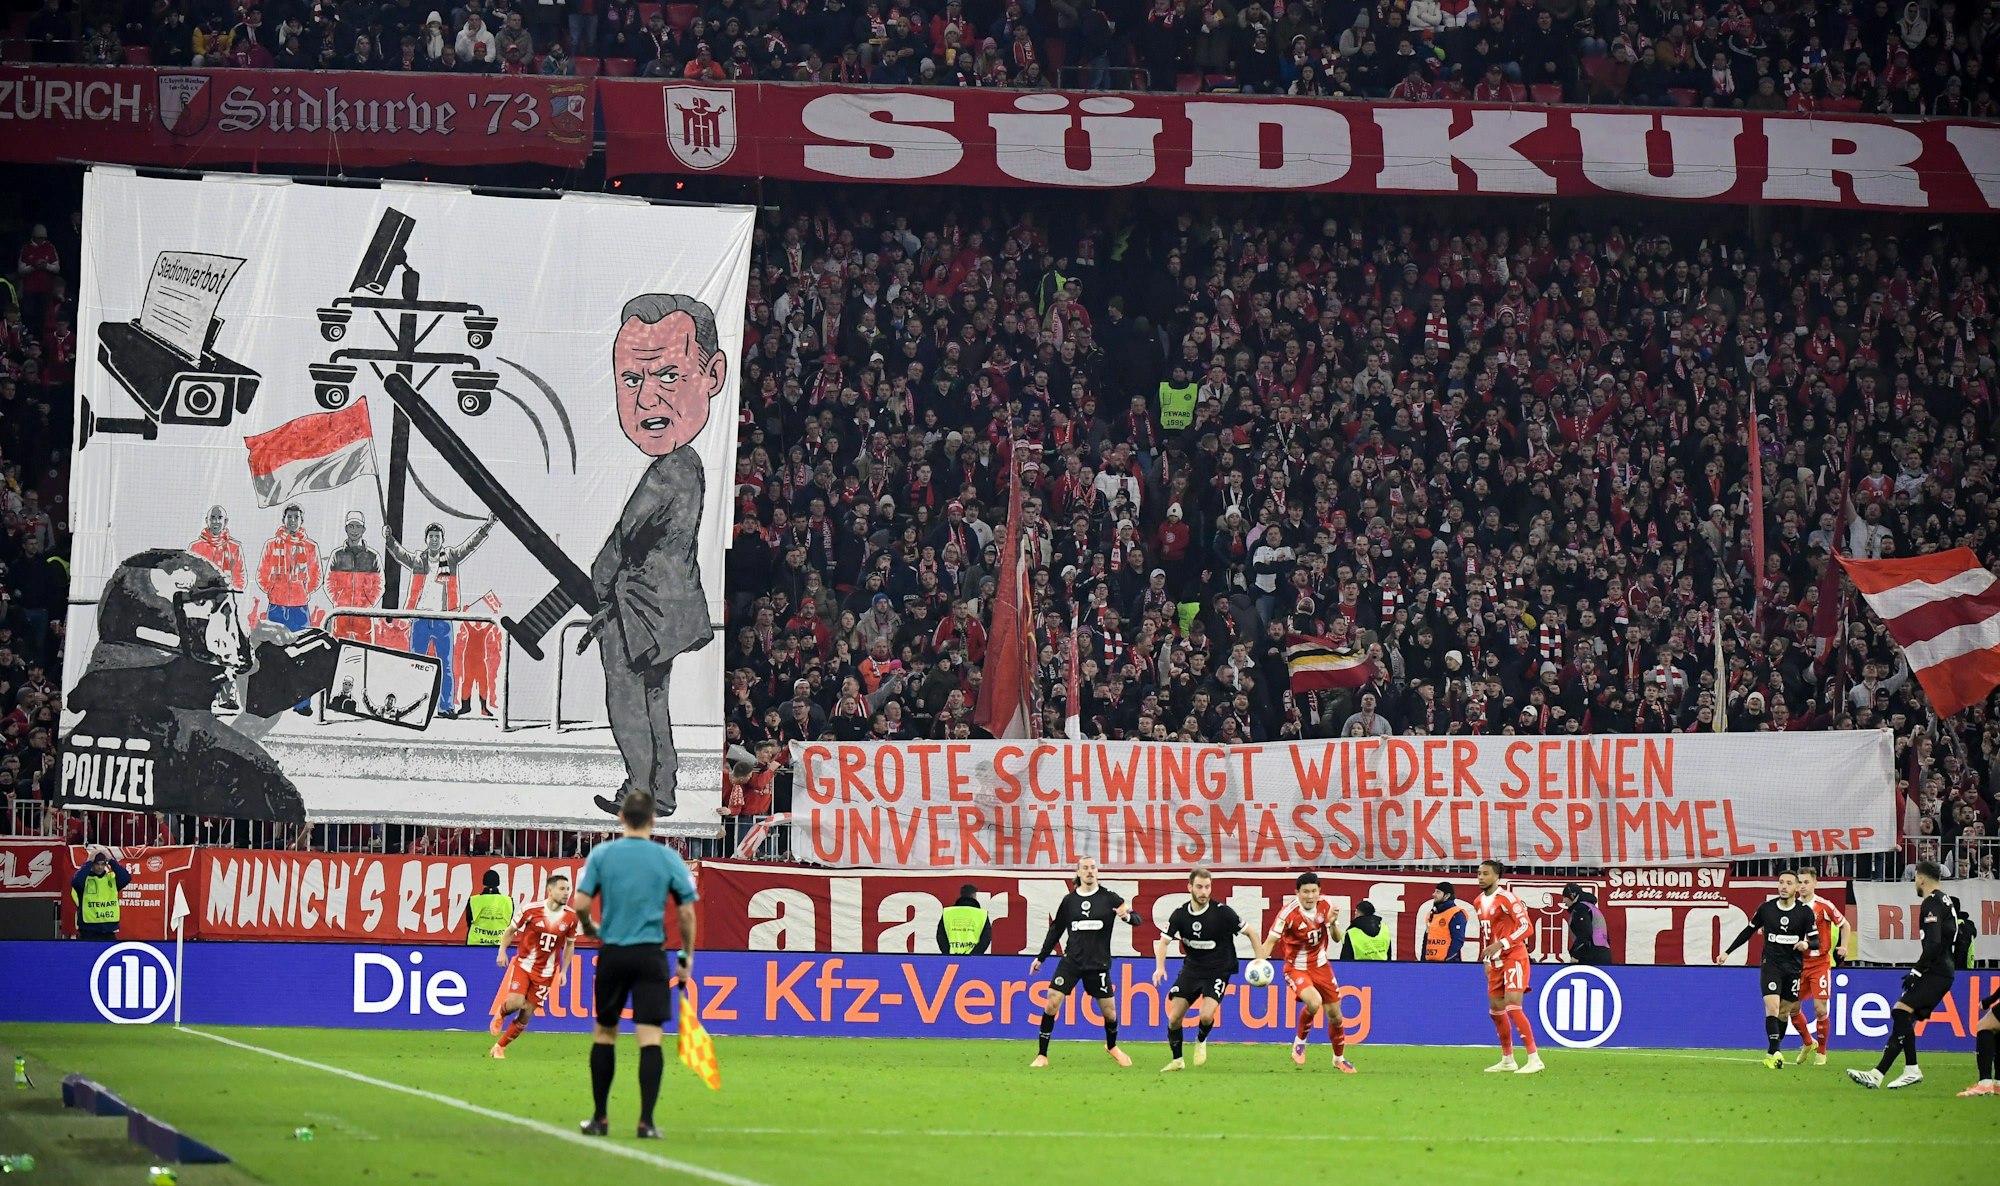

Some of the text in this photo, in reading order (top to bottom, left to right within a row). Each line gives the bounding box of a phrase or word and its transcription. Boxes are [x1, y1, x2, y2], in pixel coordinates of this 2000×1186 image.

[218, 86, 541, 135] Südkurve '73
[157, 256, 228, 295] Stadionverbot
[414, 663, 430, 672] REC
[60, 752, 155, 806] POLIZEI
[803, 737, 1675, 804] GROTE SCHWINGT WIEDER SEINEN
[1792, 827, 1876, 853] MRP
[206, 856, 386, 934] MUNICH'S
[397, 859, 474, 935] RED
[1608, 868, 1726, 888] Sektion SV
[1608, 888, 1633, 899] des
[1636, 887, 1663, 899] sitz
[1665, 890, 1690, 900] ma
[353, 951, 468, 1016] Die
[1099, 972, 1107, 987] 7
[1819, 974, 1828, 989] 6
[1784, 973, 1891, 1038] ie
